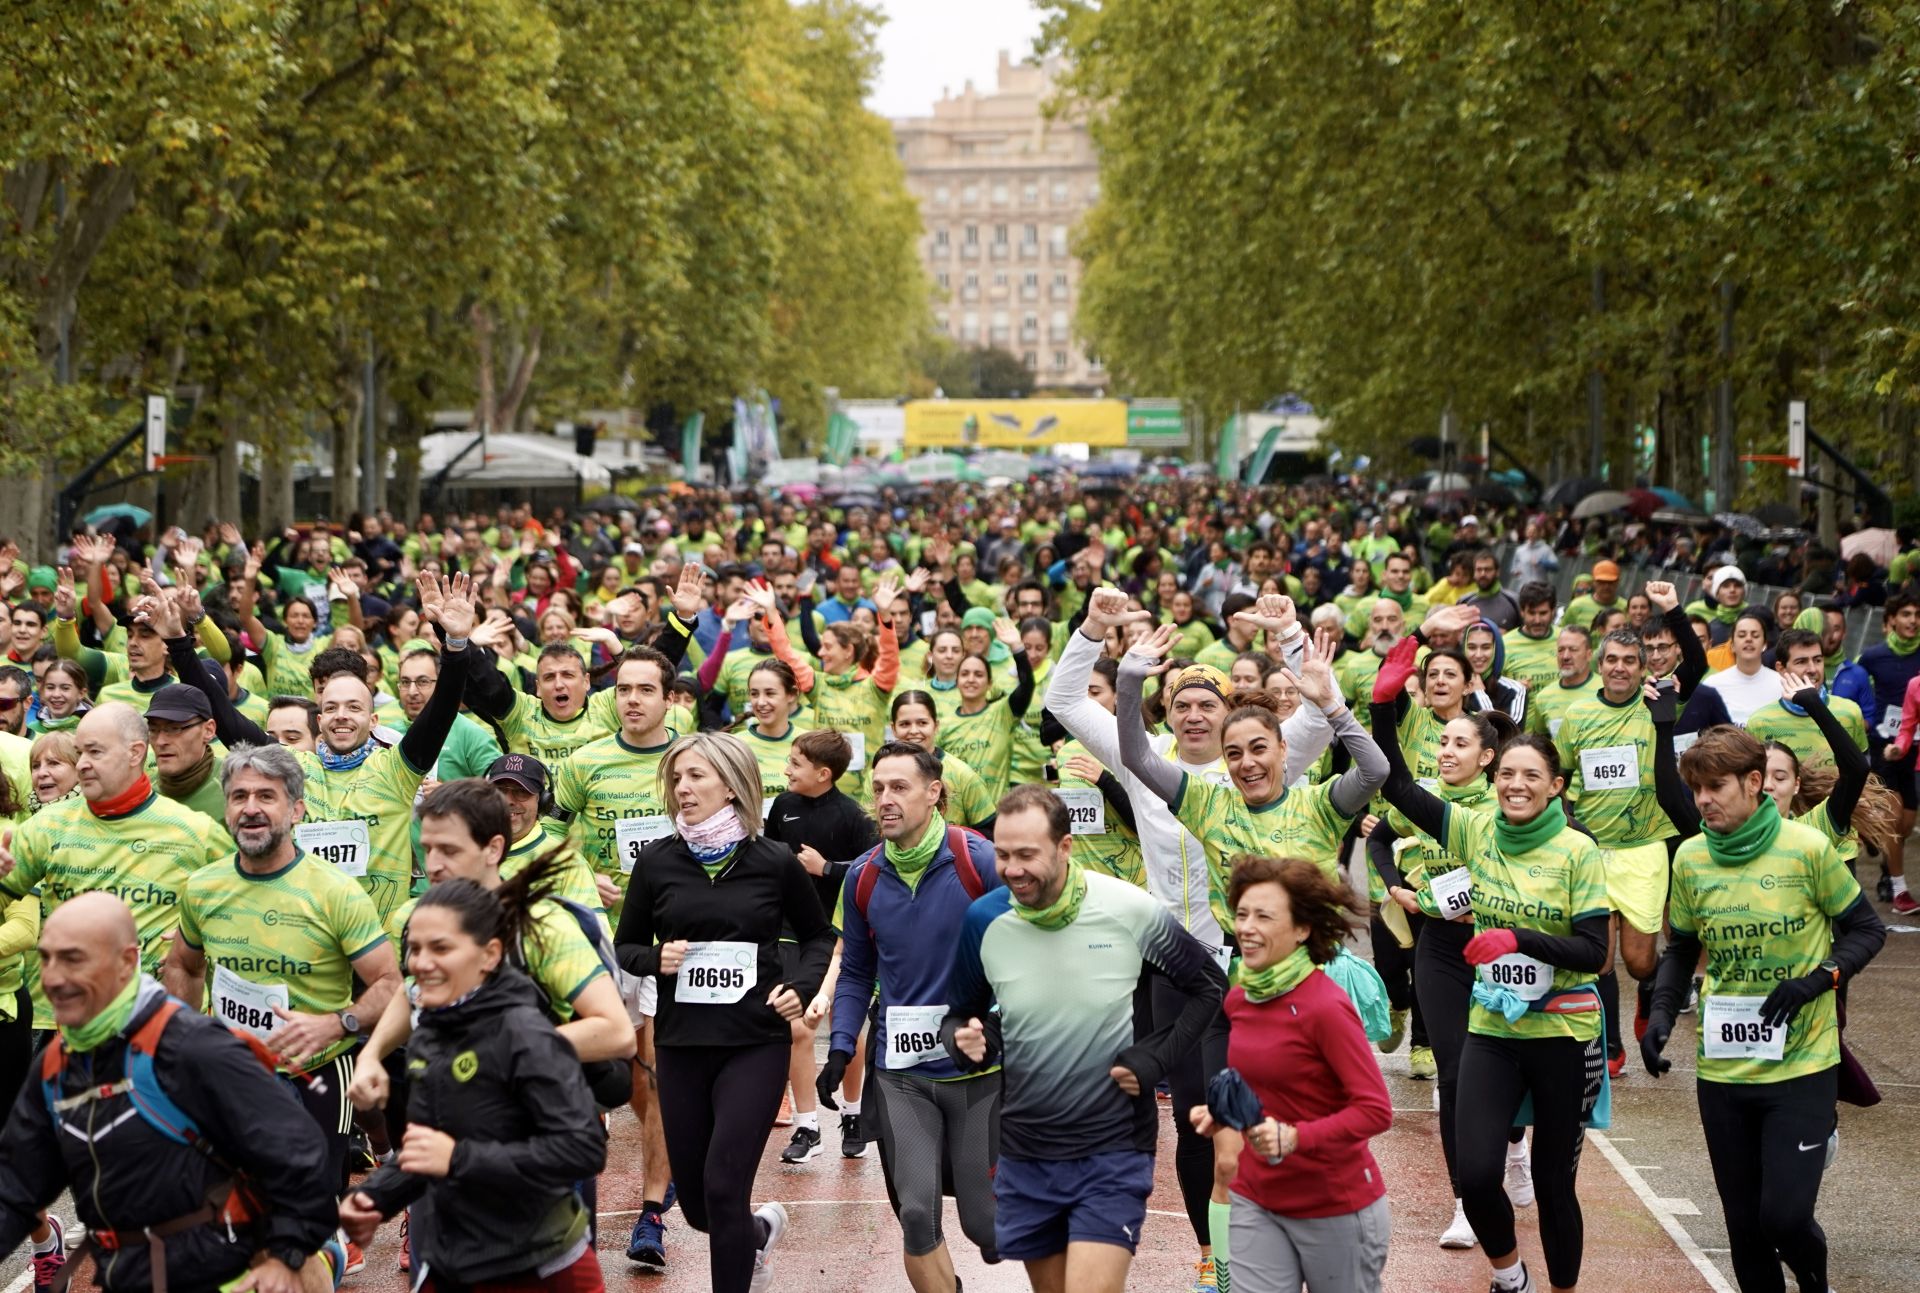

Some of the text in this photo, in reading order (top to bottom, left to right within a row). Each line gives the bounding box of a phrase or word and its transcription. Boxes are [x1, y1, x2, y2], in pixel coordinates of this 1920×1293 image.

[1594, 764, 1626, 779] 4692
[608, 792, 650, 800] Valladolid
[1447, 888, 1471, 911] 50
[1488, 894, 1563, 922] marcha
[1723, 915, 1805, 941] marcha
[688, 967, 744, 988] 18695
[1491, 964, 1536, 985] 8036
[220, 996, 273, 1031] 18884
[1721, 1022, 1773, 1043] 8035
